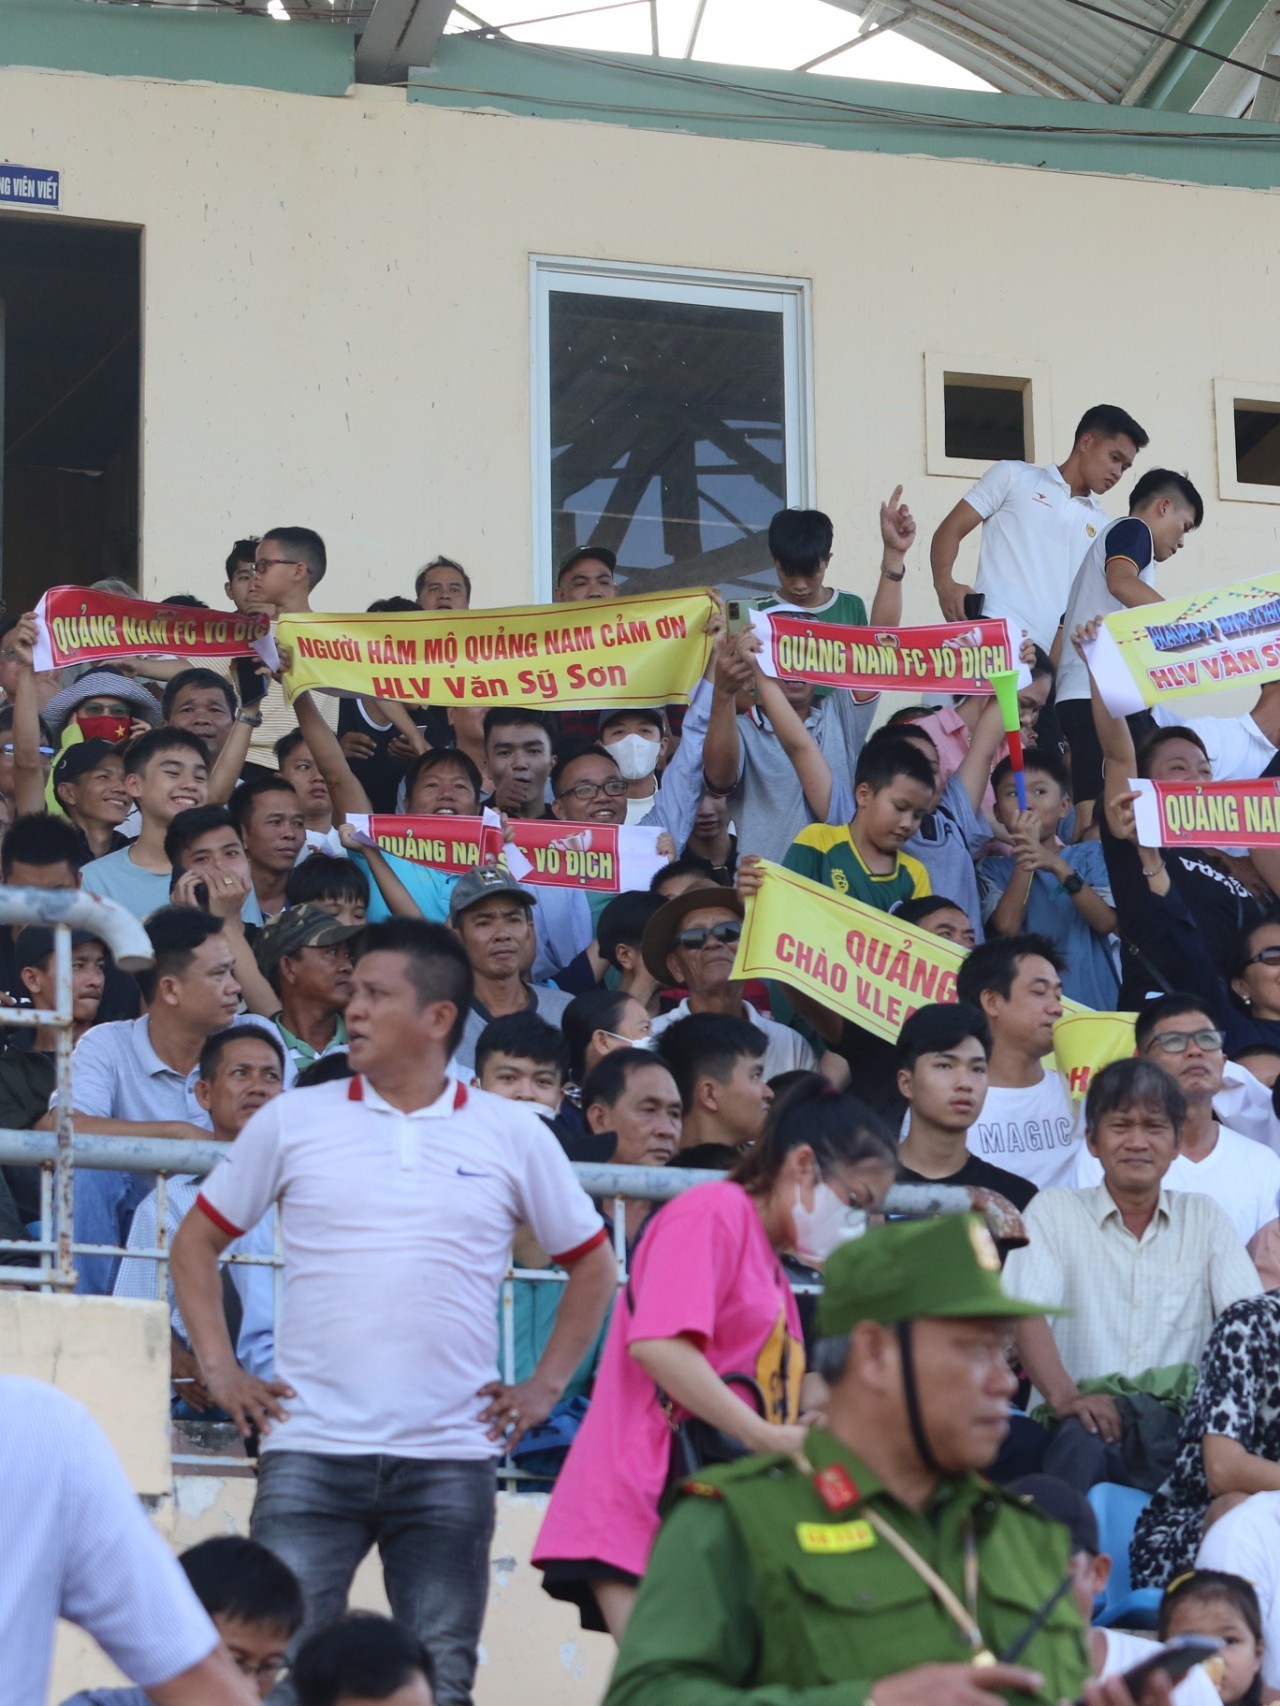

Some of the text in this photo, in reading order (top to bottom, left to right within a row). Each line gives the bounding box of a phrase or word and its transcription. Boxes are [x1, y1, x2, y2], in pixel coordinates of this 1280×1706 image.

[13, 175, 35, 198] VIÊN
[37, 176, 57, 200] VIẾT
[52, 604, 120, 654] QUẢNG
[122, 616, 170, 646] NAM
[173, 619, 196, 646] FC
[296, 613, 688, 669] NGƯỜI HÂM MỘ QUẢNG NAM CẢM ƠN
[1144, 619, 1215, 650] HAPPY
[778, 630, 1006, 687] QUẢNG NAM FC VÔ ĐỊCH
[1149, 660, 1198, 690] HLV
[1202, 650, 1260, 681] VĂN
[372, 664, 627, 700] HLV Văn Sỹ Sơn
[1165, 786, 1238, 836] QUẢNG
[451, 841, 479, 866] NA
[534, 844, 560, 875] VÔ
[566, 850, 612, 884] ĐỊCH
[775, 932, 848, 994] CHÀO
[845, 928, 958, 1004] QUẢNG
[979, 1117, 1072, 1154] MAGIC
